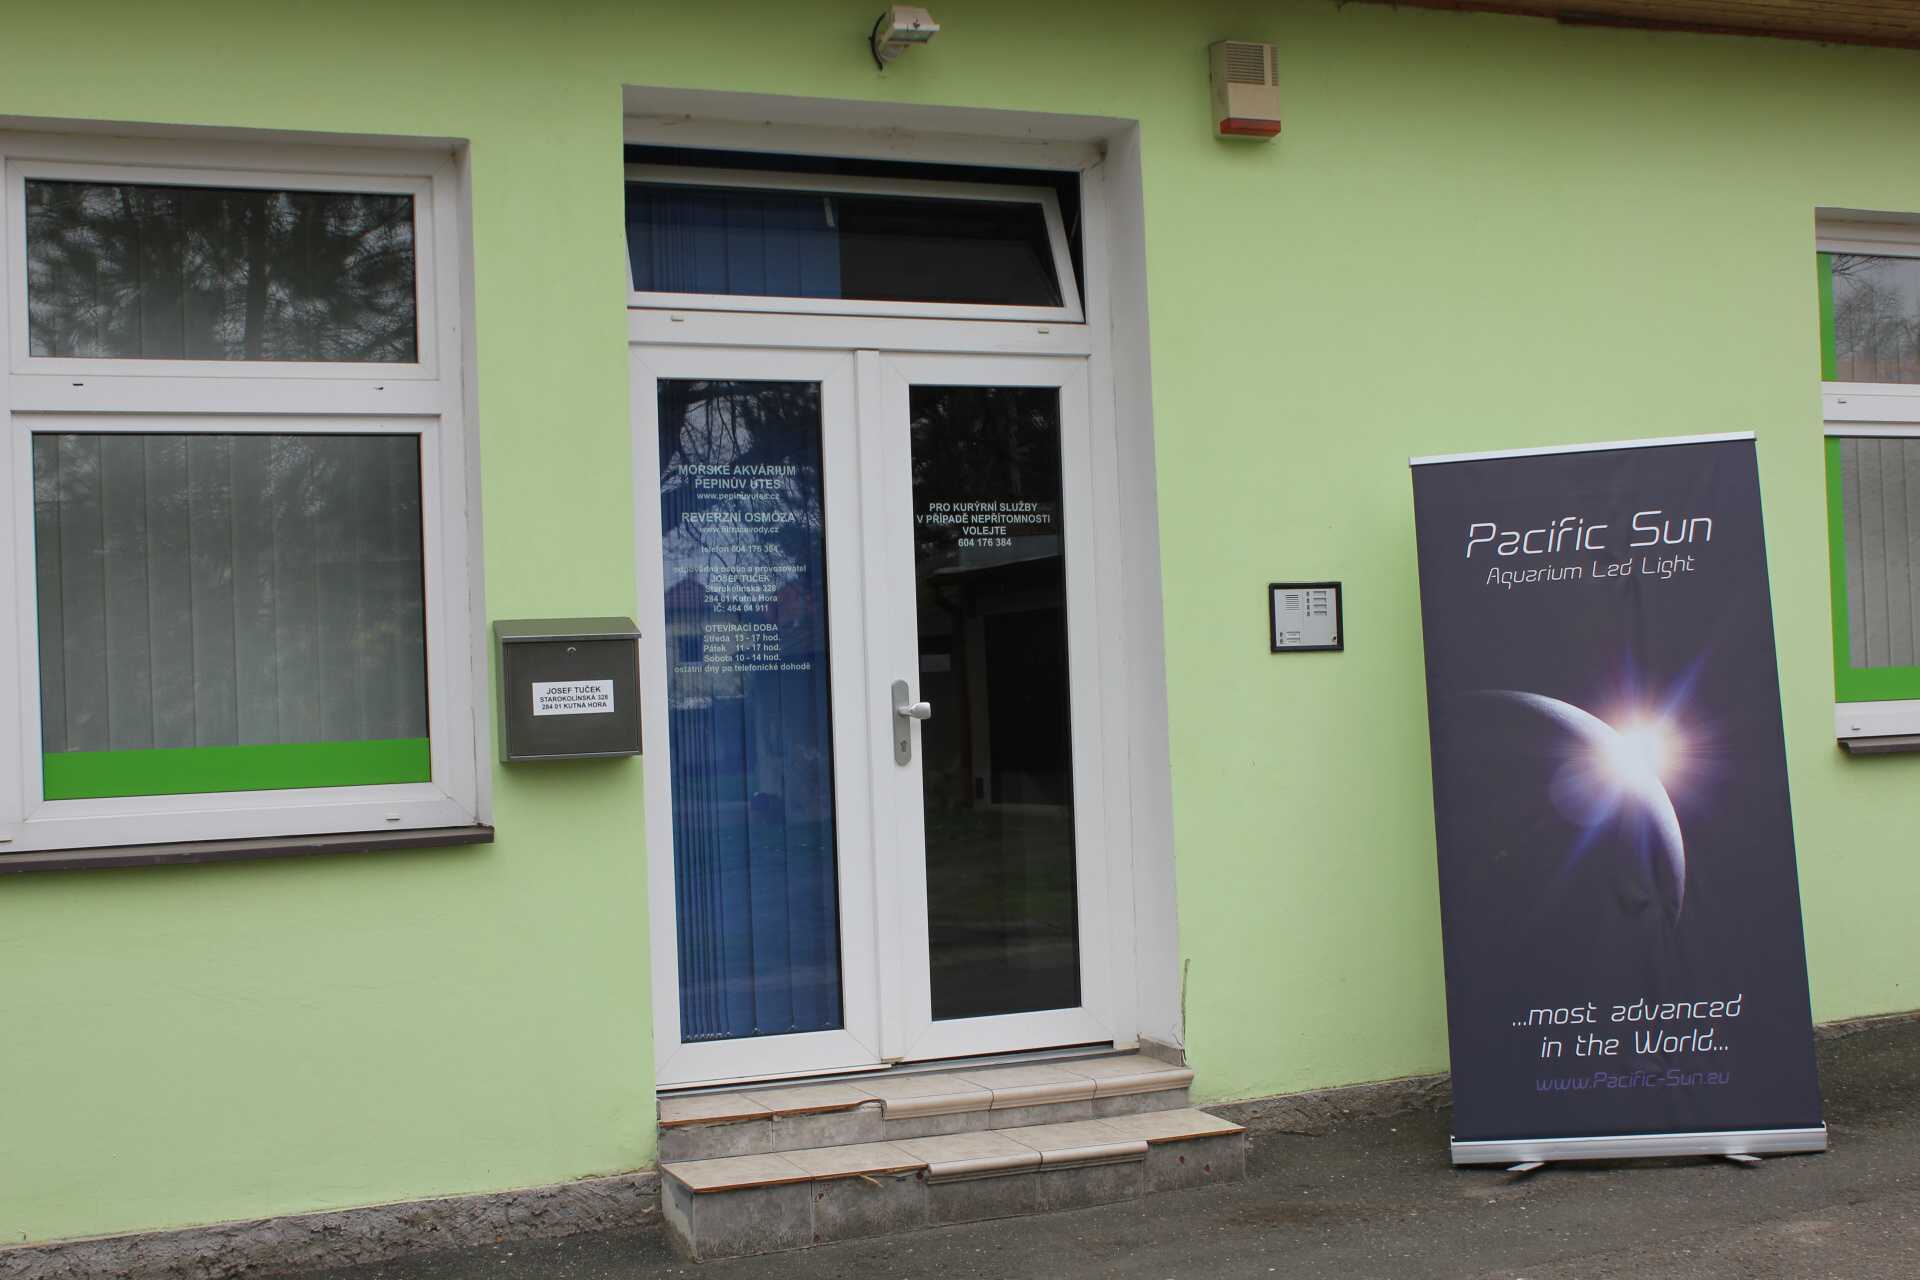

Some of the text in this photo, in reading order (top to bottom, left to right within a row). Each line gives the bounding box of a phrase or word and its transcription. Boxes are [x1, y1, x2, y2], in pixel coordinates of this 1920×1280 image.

[679, 464, 796, 476] MOŘSKÉ AKVÁRIUM
[929, 500, 1038, 512] PRO KURÝRNÍ SLUŽBY
[681, 511, 742, 523] REVERZNÍ
[916, 513, 1051, 524] V PŘÍPADĚ NEPŘÍTOMNOSTI
[962, 526, 1007, 536] VOLEJTE
[1466, 510, 1712, 558] Pacific Sun
[958, 538, 975, 547] 604
[977, 538, 993, 547] 176
[1486, 554, 1695, 590] Aquarium Led Light
[758, 593, 778, 601] Hora
[753, 623, 778, 631] DOBA
[763, 643, 781, 651] hod.
[763, 653, 781, 661] hod.
[1611, 993, 1742, 1022] advanced
[1541, 1027, 1729, 1058] in the World...
